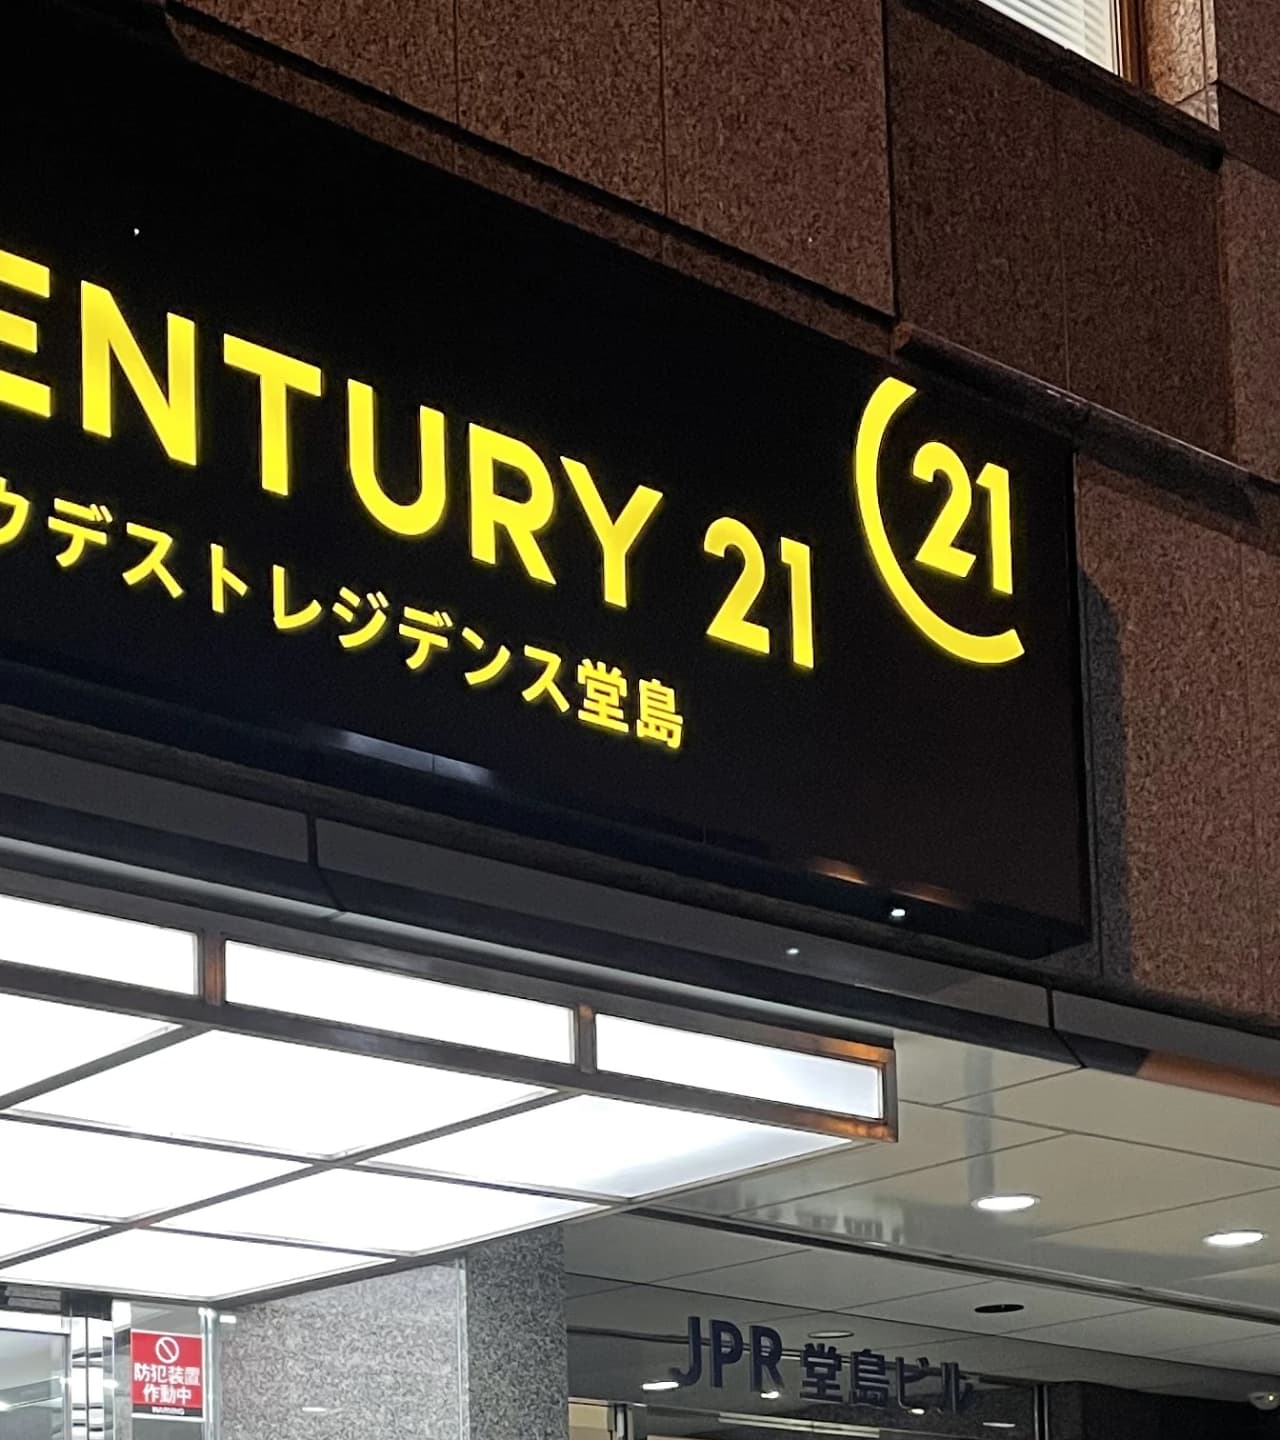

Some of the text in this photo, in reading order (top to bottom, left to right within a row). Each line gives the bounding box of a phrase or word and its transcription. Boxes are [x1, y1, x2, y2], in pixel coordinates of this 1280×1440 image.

[704, 516, 814, 669] 21
[134, 1362, 201, 1386] 防犯装置
[143, 1383, 192, 1405] 作動中
[668, 1317, 973, 1412] JPR 堂島ビル
